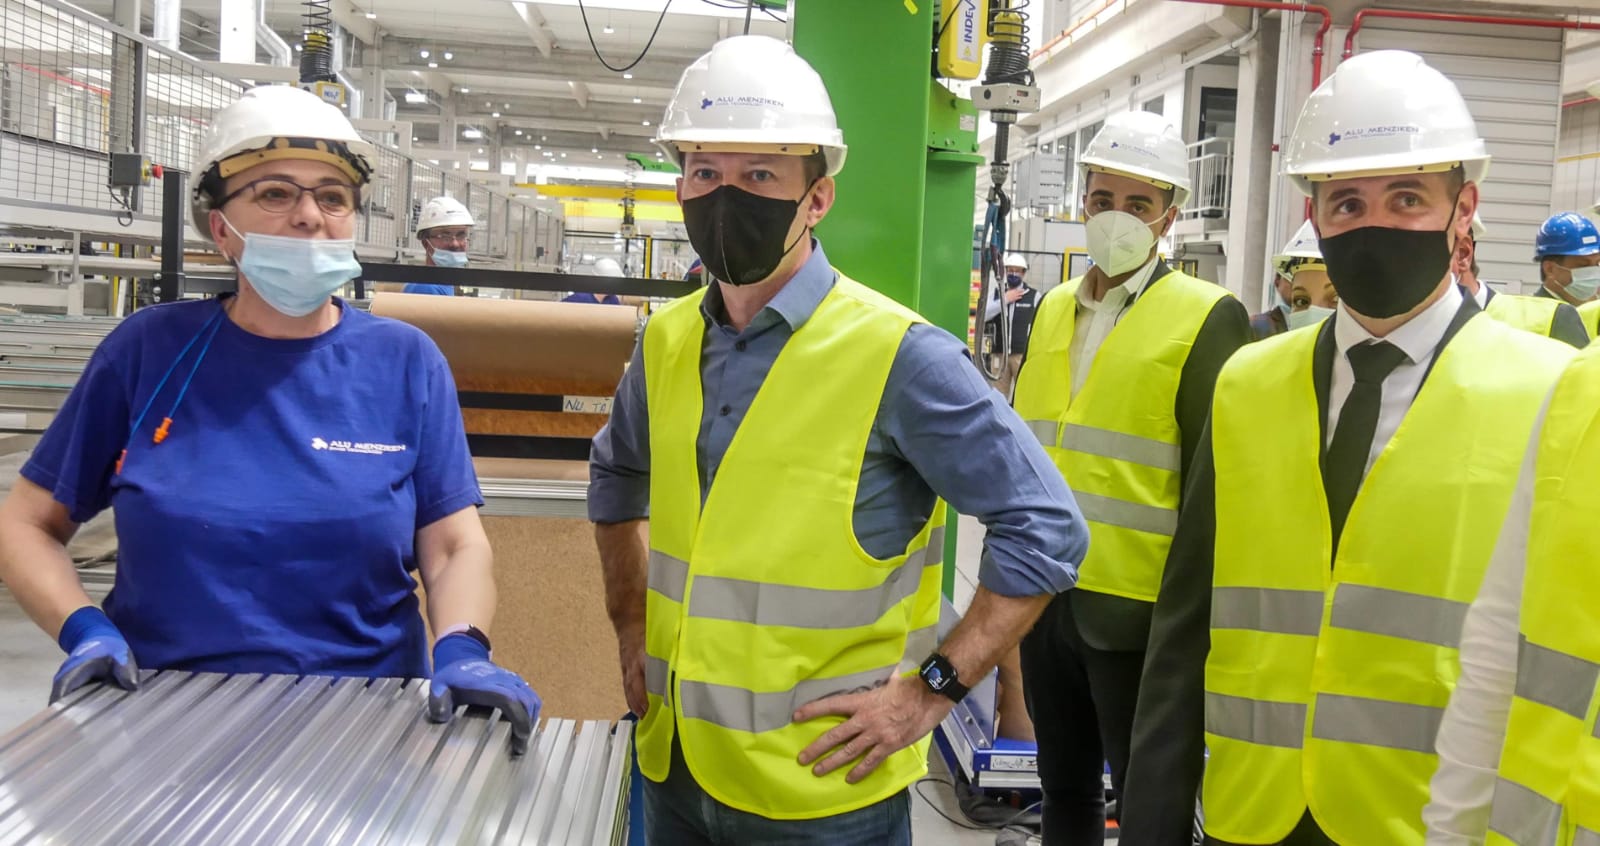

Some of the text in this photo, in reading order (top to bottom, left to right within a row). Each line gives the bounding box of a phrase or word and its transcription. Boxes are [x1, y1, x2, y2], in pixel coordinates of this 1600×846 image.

[963, 0, 976, 43] INDEV
[737, 96, 784, 107] MENZIKEN
[1344, 128, 1363, 136] ALU
[565, 398, 584, 411] NU
[330, 440, 351, 449] ALU
